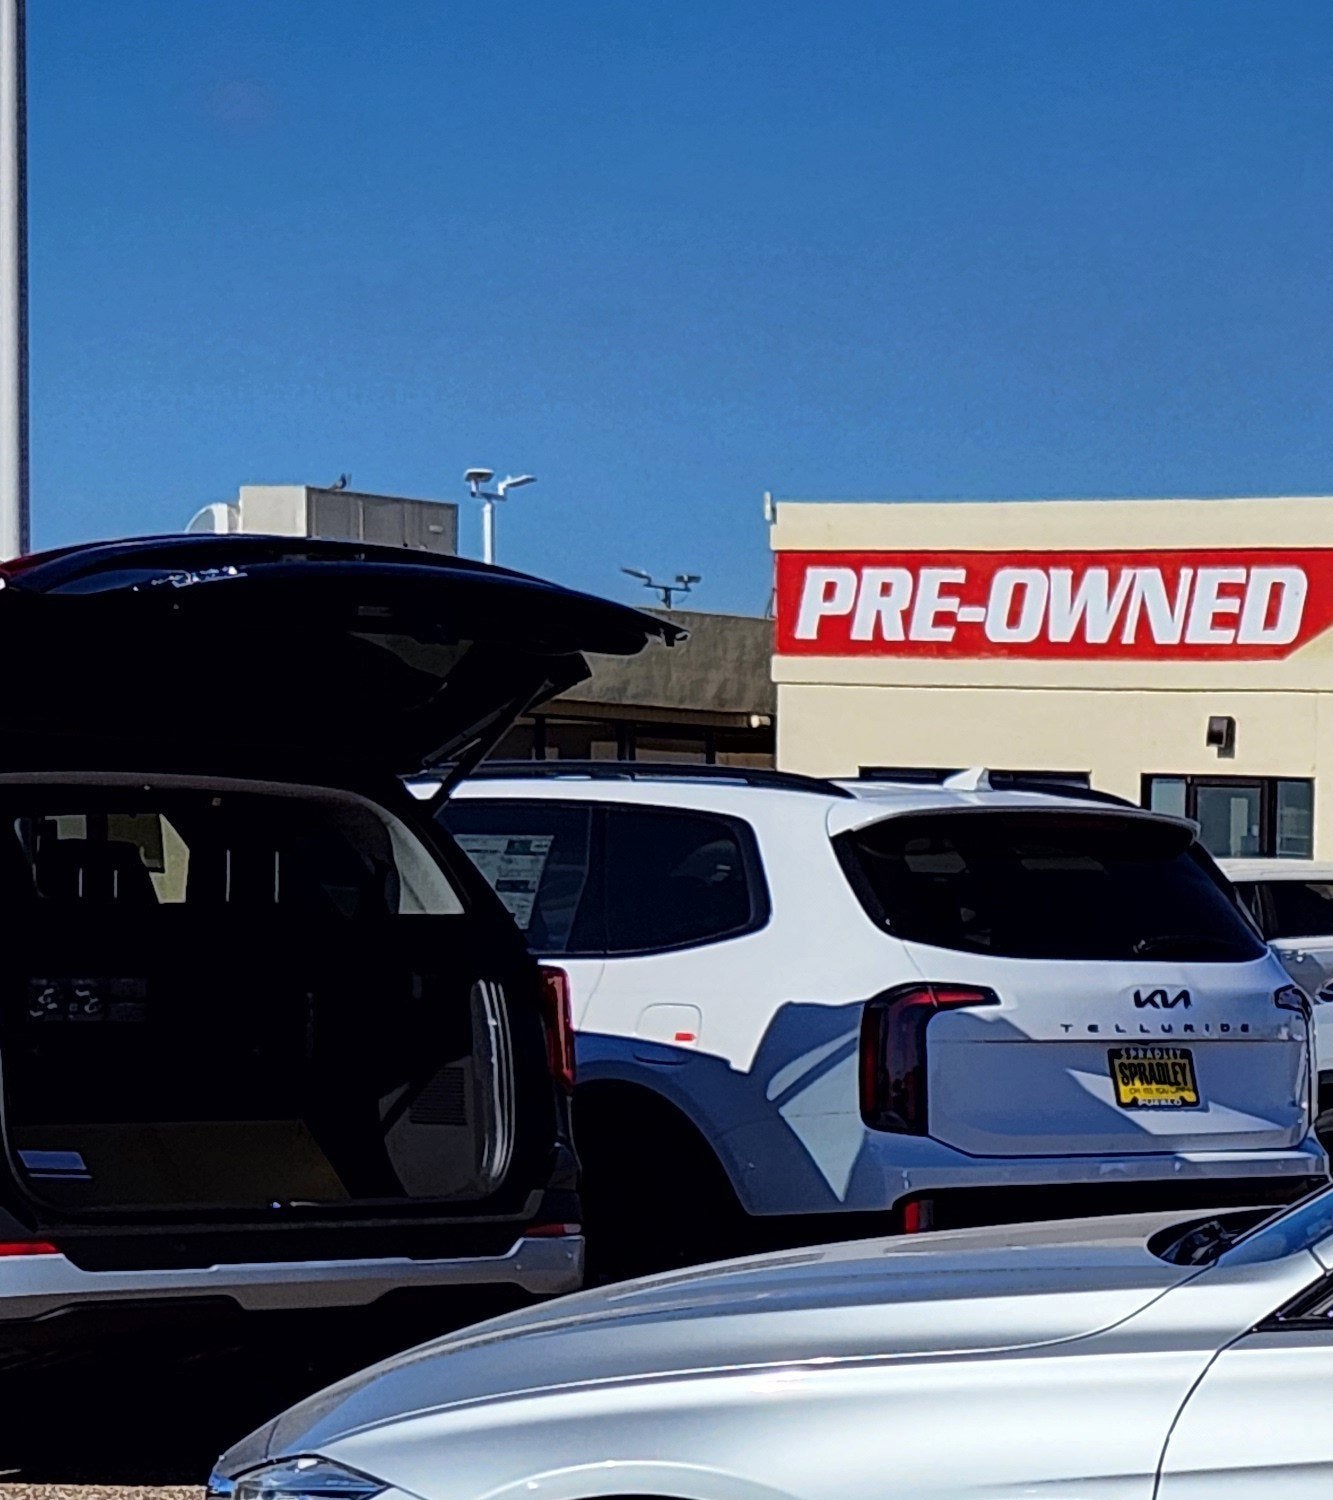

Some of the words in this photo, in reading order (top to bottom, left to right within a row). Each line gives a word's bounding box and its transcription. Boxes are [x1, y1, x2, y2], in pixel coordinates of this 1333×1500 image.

[794, 565, 1309, 645] PRE-OWNED
[1133, 989, 1192, 1009] KIA
[1060, 1023, 1250, 1034] TELLURIDE
[1118, 1062, 1188, 1086] SPRADLEY
